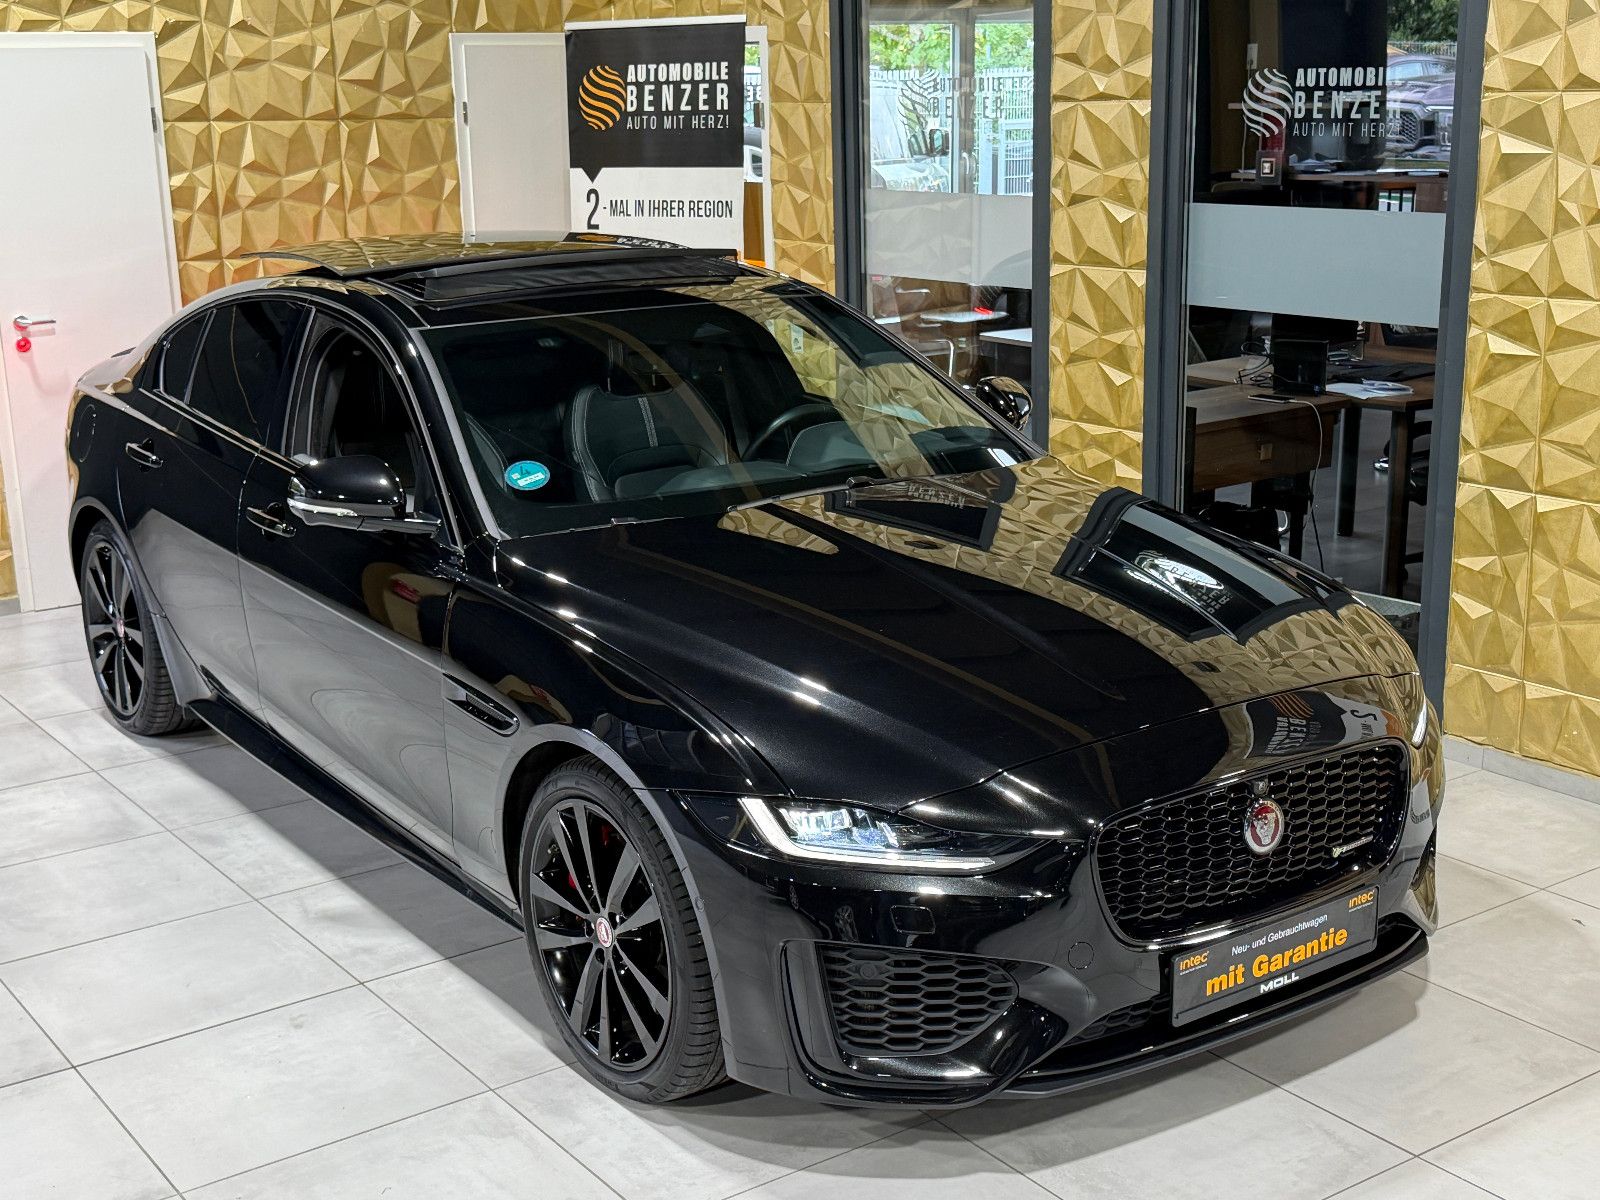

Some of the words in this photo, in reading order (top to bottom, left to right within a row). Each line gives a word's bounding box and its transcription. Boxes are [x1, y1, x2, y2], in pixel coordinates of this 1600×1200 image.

[626, 61, 729, 83] AUTOMOBILE
[626, 83, 729, 112] BENZER
[626, 116, 657, 130] AUTO
[663, 115, 684, 130] MIT
[691, 114, 729, 129] HERZ!
[1293, 122, 1325, 137] AUTO
[1332, 122, 1354, 137] MIT
[586, 188, 600, 230] 2
[609, 199, 631, 217] MAL
[634, 200, 645, 217] IN
[649, 199, 685, 218] IHRER
[688, 199, 733, 218] REGION
[1348, 890, 1375, 908] intec
[1231, 943, 1250, 957] Neu-
[1252, 936, 1266, 949] und
[1267, 914, 1328, 943] Gebrauchtwagen
[1179, 951, 1209, 971] intec
[1206, 963, 1245, 997] mit
[1252, 927, 1348, 978] Garantie
[1260, 972, 1300, 994] MOLL
